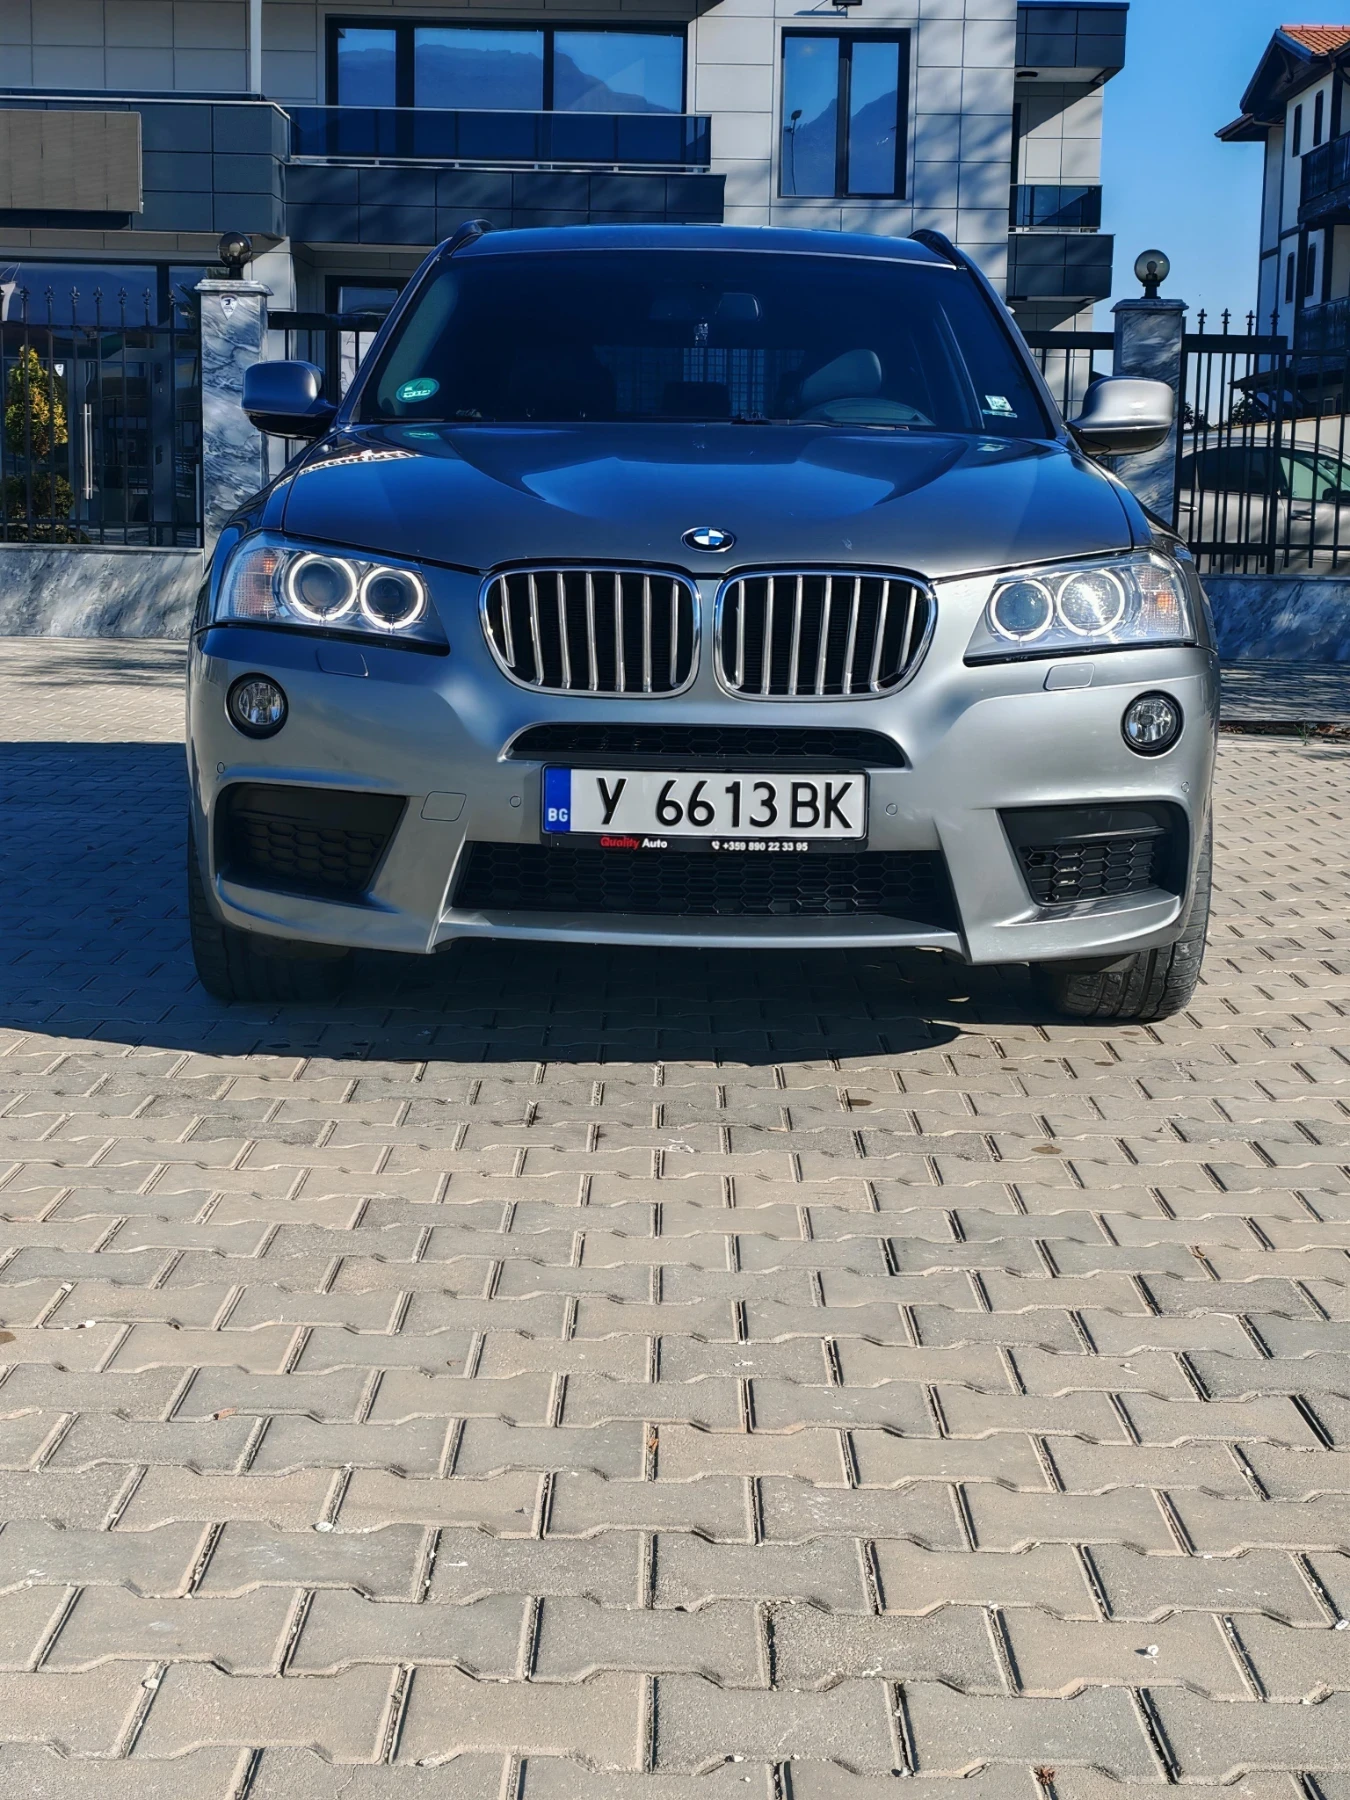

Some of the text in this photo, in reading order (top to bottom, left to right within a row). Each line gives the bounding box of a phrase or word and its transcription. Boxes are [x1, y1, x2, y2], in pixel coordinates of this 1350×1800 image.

[548, 808, 568, 822] BG
[600, 836, 668, 850] Quality Auto
[722, 841, 808, 851] +359 890 22 33 95
